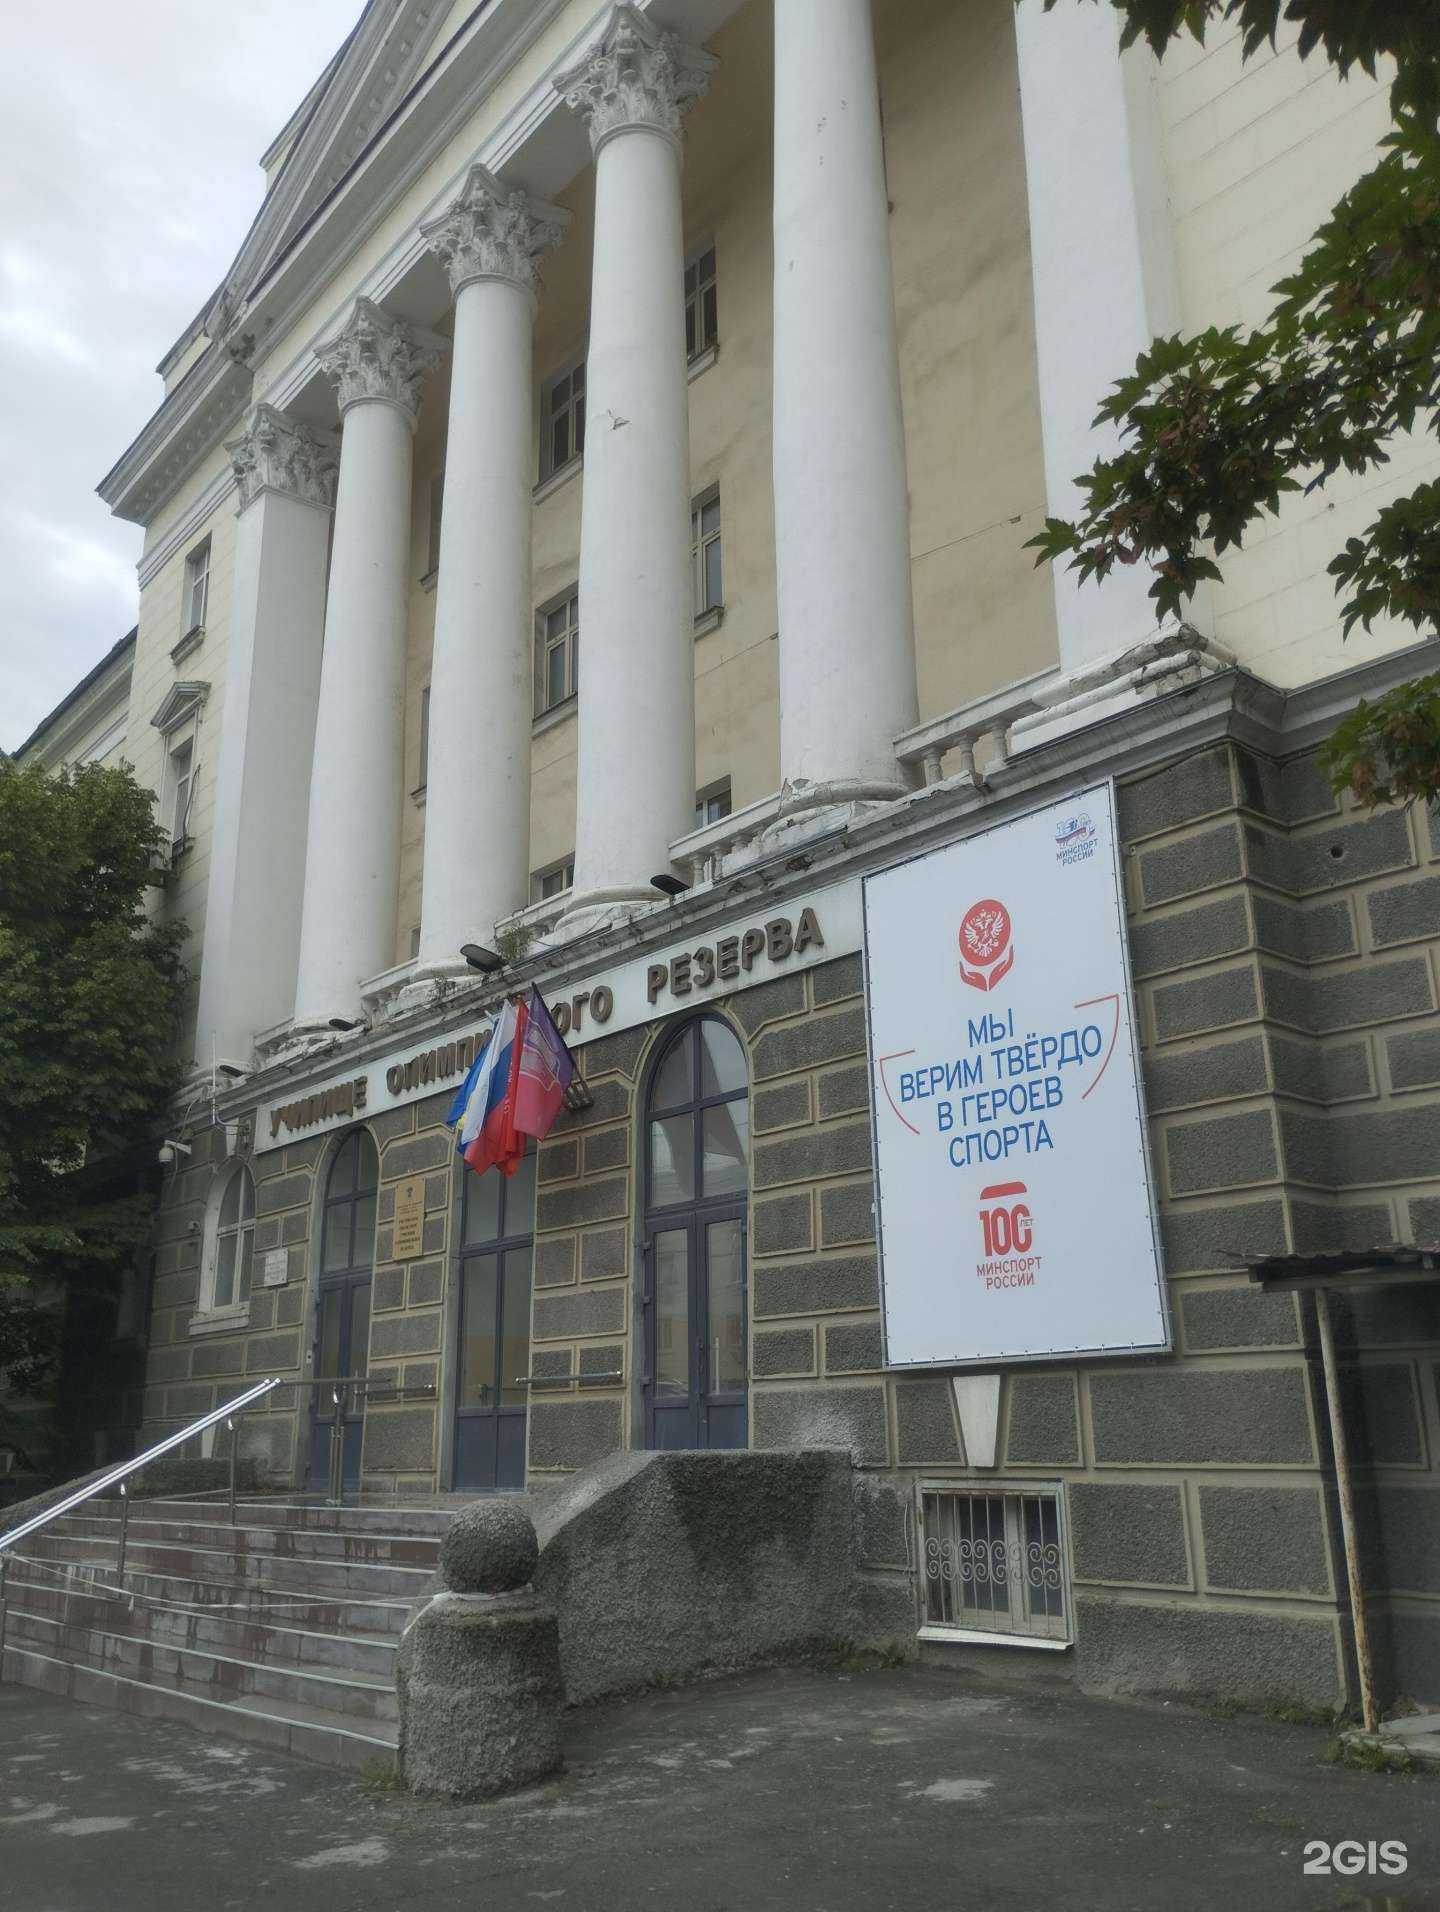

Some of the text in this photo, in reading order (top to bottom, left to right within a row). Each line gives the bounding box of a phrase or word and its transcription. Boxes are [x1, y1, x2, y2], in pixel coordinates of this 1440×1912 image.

[1056, 838, 1098, 861] МИНСПОРТ
[1062, 849, 1093, 867] РОССИИ
[647, 907, 824, 1004] РЕЗЕРВА
[968, 1008, 1014, 1047] МЫ
[900, 1025, 1102, 1102] ВЕРИМ ТВЁРДО
[937, 1075, 1064, 1131] В ГЕРОЕВ
[949, 1119, 1054, 1167] СПОРТА
[979, 1204, 1032, 1256] 100
[976, 1257, 1042, 1277] МИНСПОРТ
[986, 1273, 1034, 1290] РОССИИ
